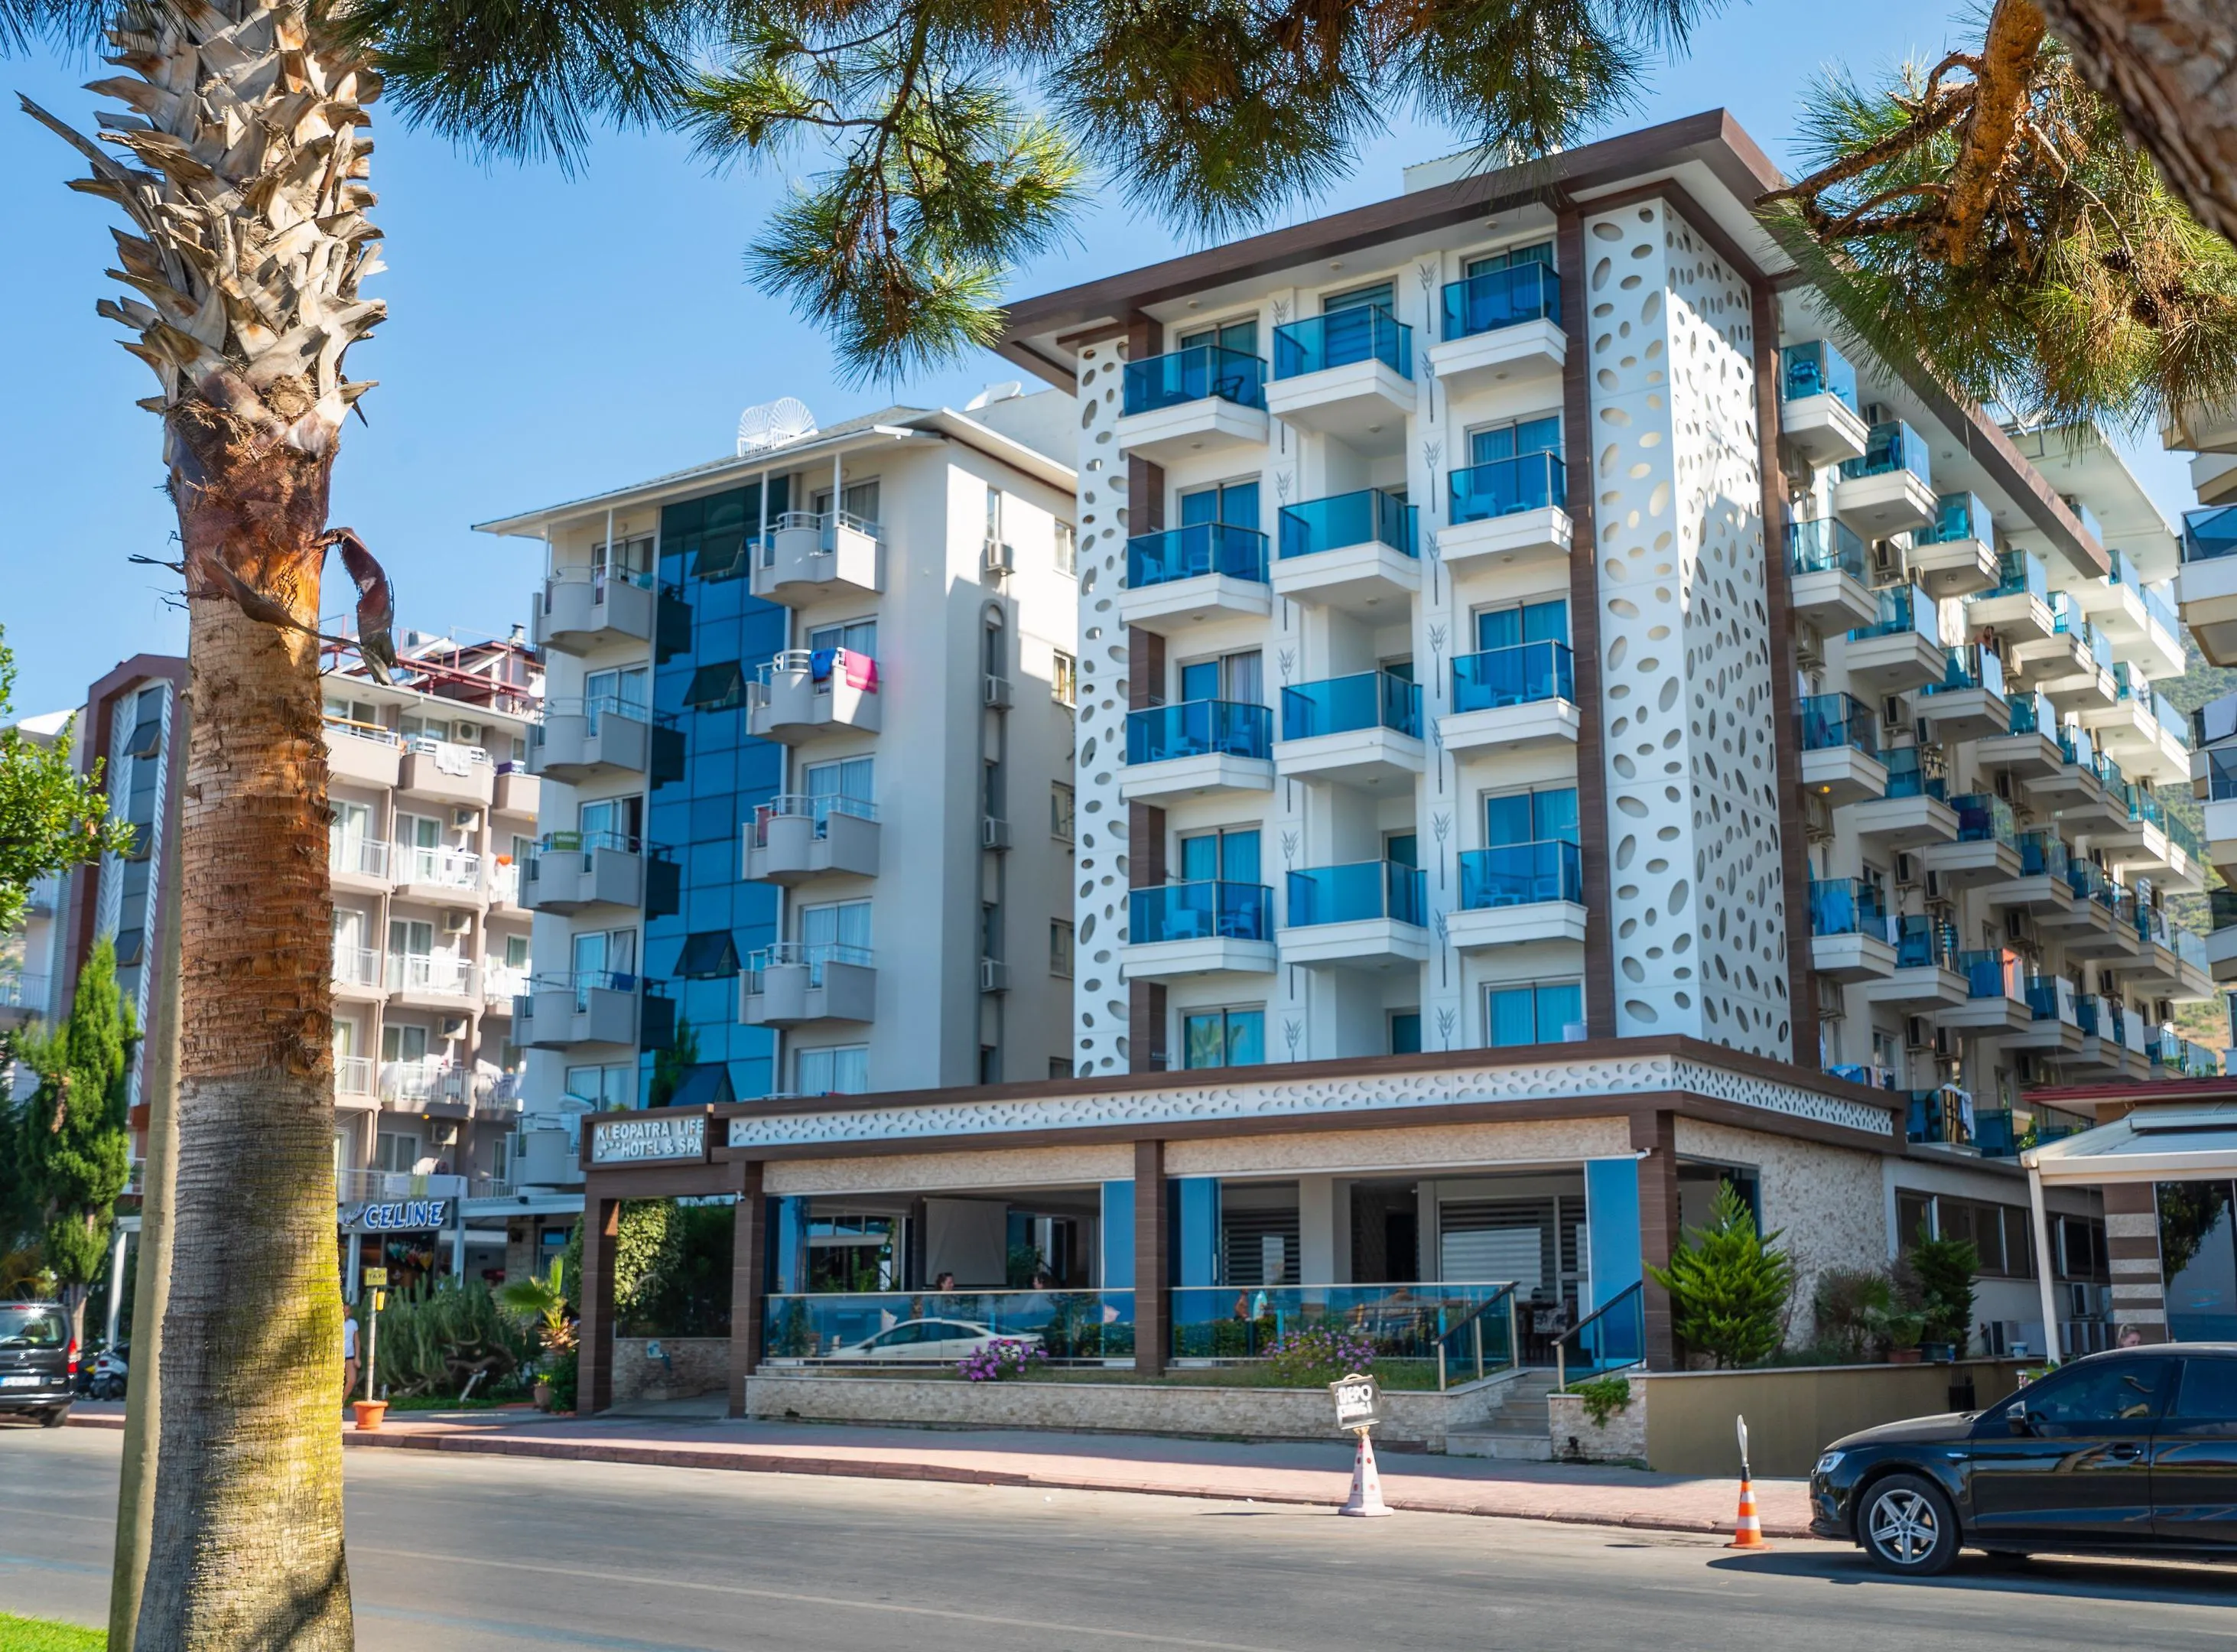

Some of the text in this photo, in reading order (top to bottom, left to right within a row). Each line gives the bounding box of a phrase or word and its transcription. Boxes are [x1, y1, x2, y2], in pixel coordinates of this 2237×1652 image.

[597, 1118, 704, 1141] KLEOPATRA LIFE
[621, 1137, 702, 1157] HOTEL & SPA
[365, 1201, 445, 1229] CELINE
